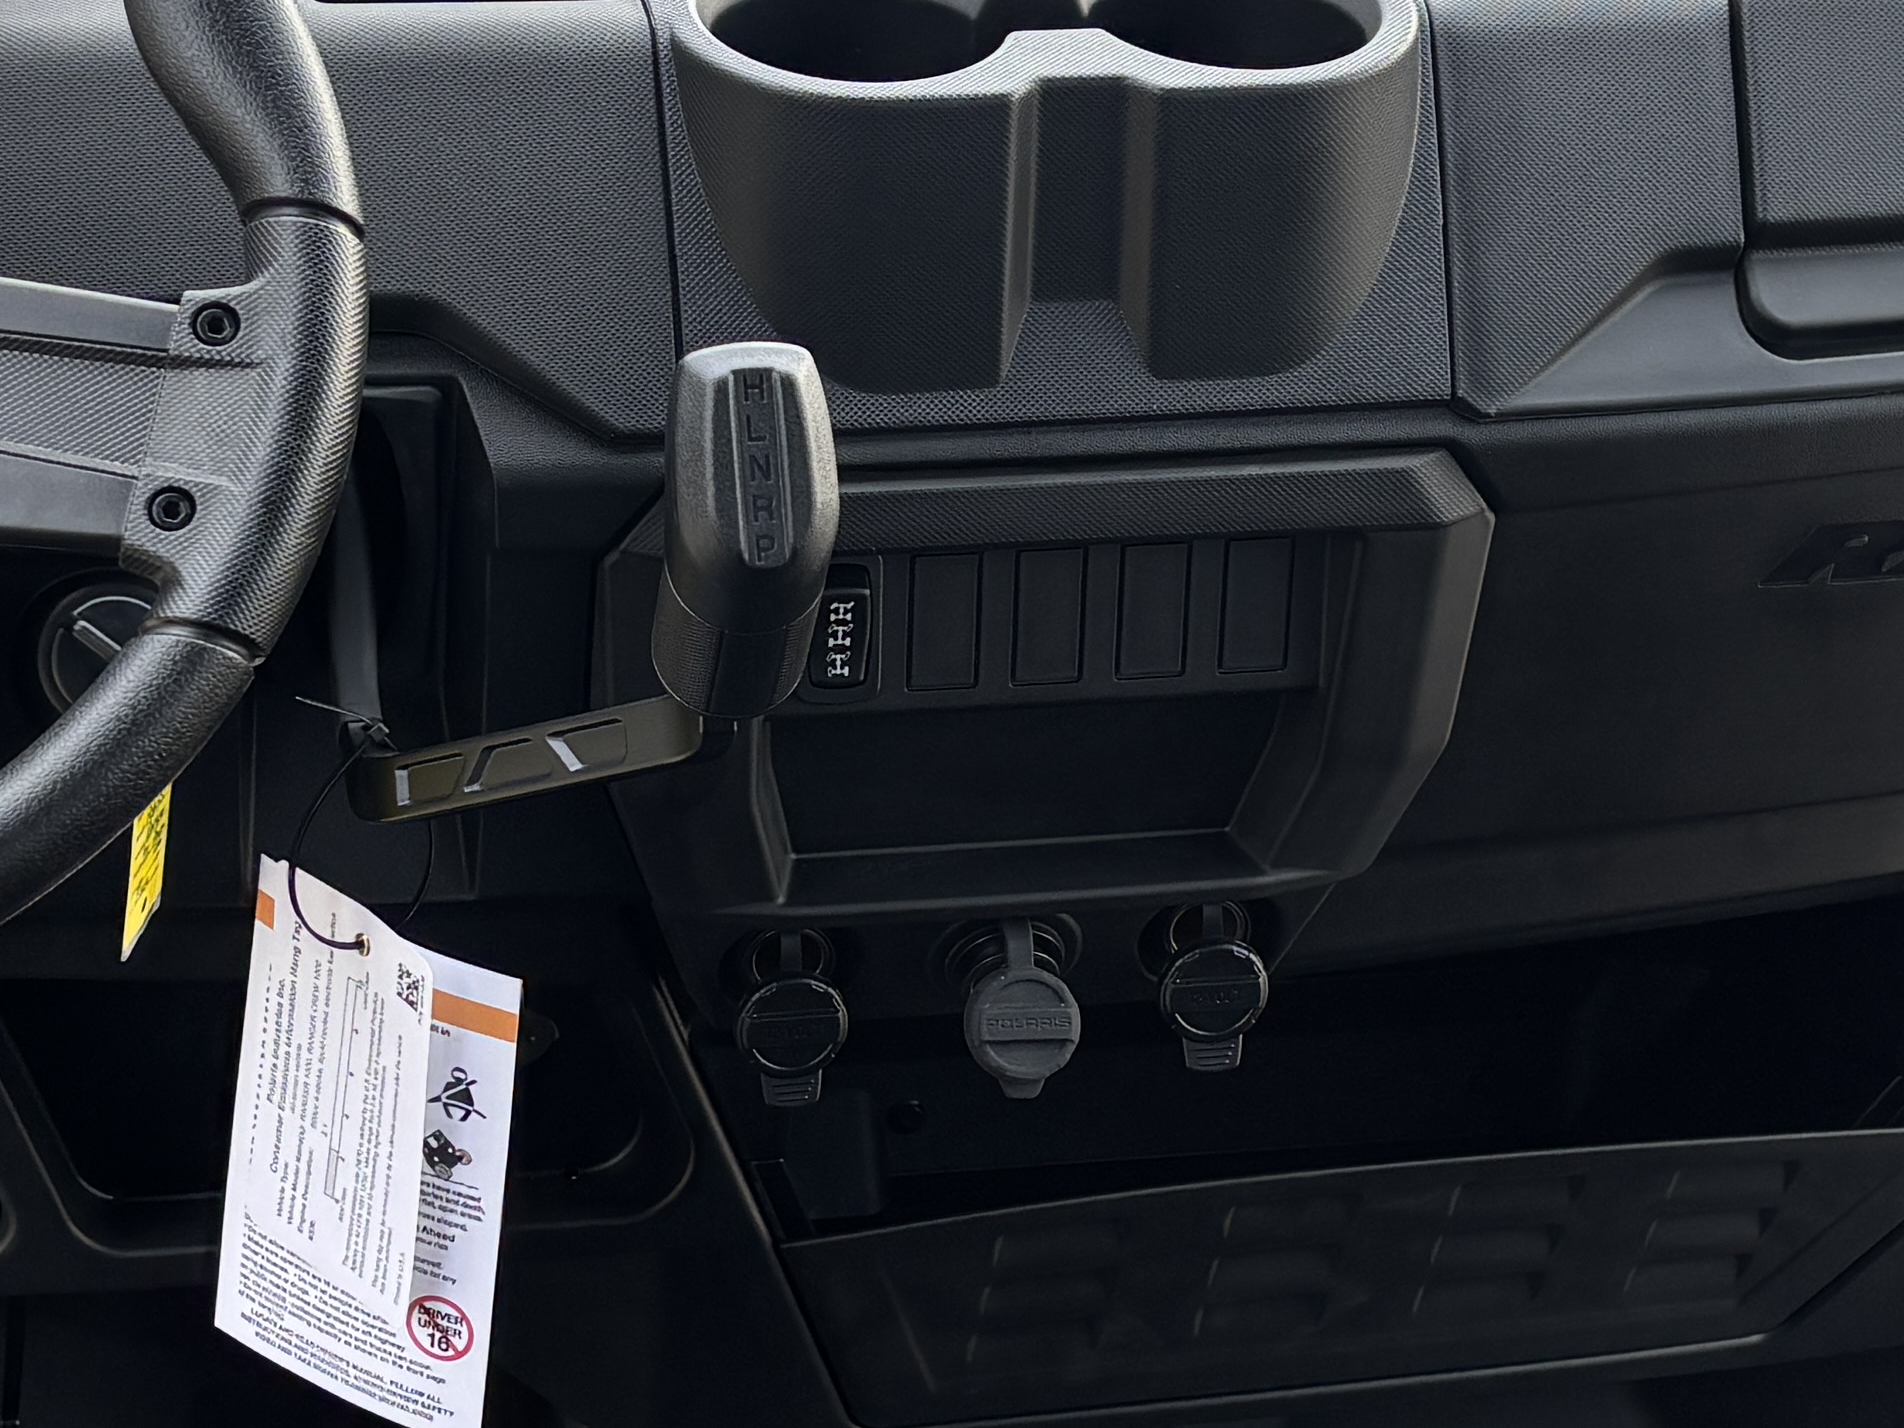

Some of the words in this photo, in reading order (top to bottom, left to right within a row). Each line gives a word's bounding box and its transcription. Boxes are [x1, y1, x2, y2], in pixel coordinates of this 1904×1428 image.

[743, 373, 767, 403] H
[747, 415, 769, 444] L
[750, 454, 773, 484] N
[752, 494, 777, 524] R
[756, 533, 778, 564] P
[986, 1017, 1072, 1029] POLARIS
[422, 1225, 455, 1242] Ahead
[417, 1317, 463, 1339] UNDER
[418, 1304, 464, 1327] DRIVER
[427, 1332, 450, 1352] 16
